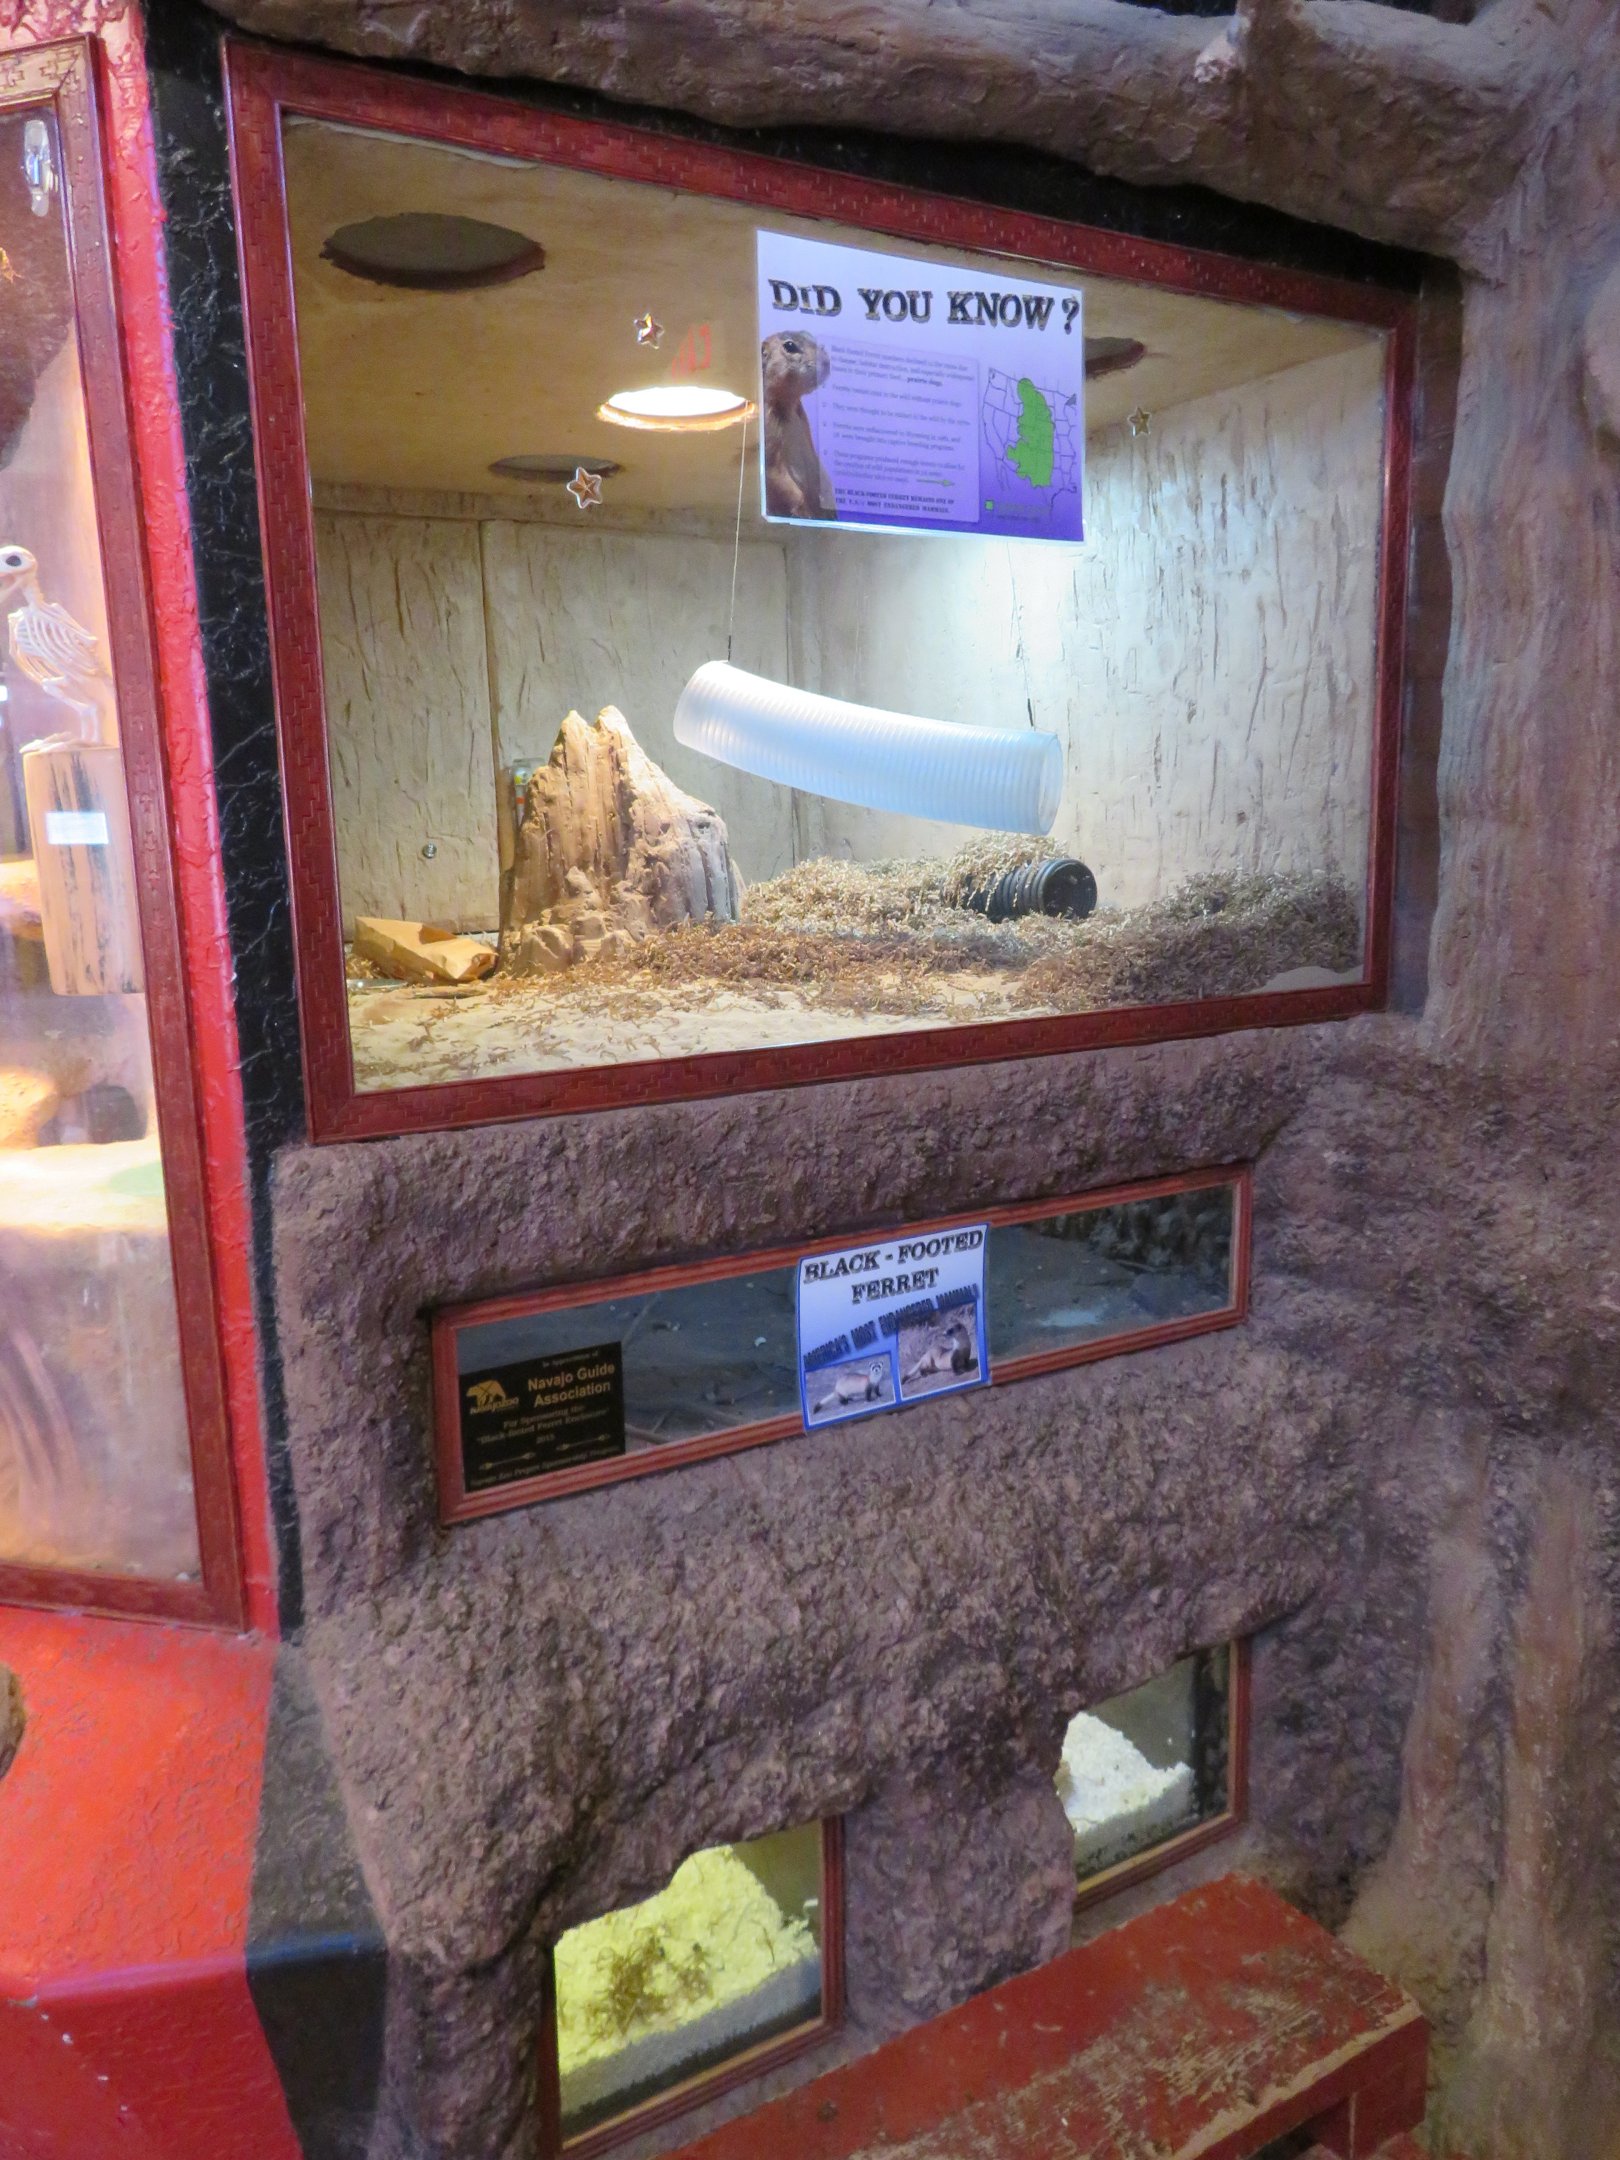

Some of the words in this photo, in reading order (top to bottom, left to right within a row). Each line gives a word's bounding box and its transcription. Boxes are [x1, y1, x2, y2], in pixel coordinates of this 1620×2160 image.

[858, 287, 933, 323] YOU
[851, 1267, 939, 1304] FERRET
[527, 1371, 573, 1393] Navajo
[577, 1362, 616, 1380] Guide
[533, 1380, 611, 1408] Association
